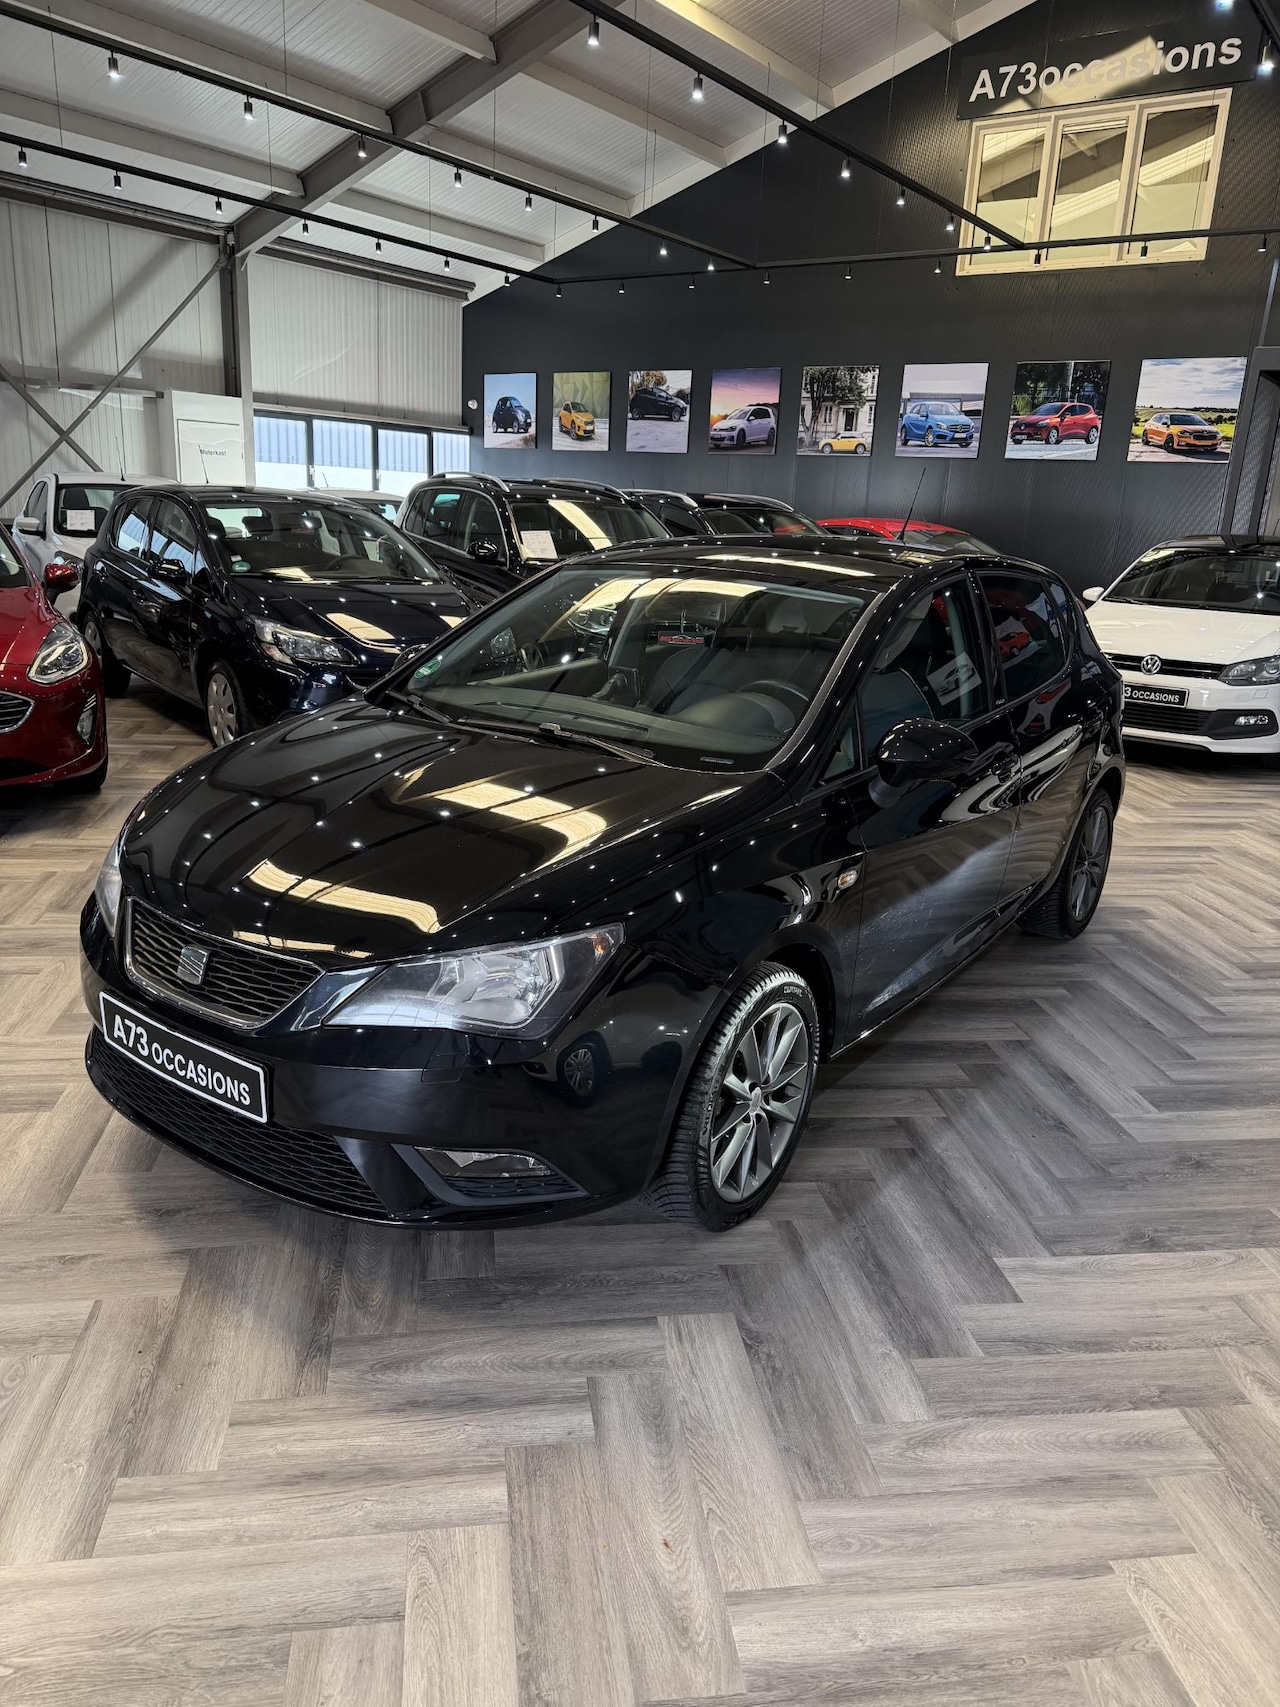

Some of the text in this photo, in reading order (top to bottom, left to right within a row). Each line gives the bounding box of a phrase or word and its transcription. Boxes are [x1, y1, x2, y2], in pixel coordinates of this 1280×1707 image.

[968, 36, 1242, 103] A73occasions
[1132, 690, 1179, 703] OCCASIONS
[113, 1014, 250, 1106] A73 OCCASIONS
